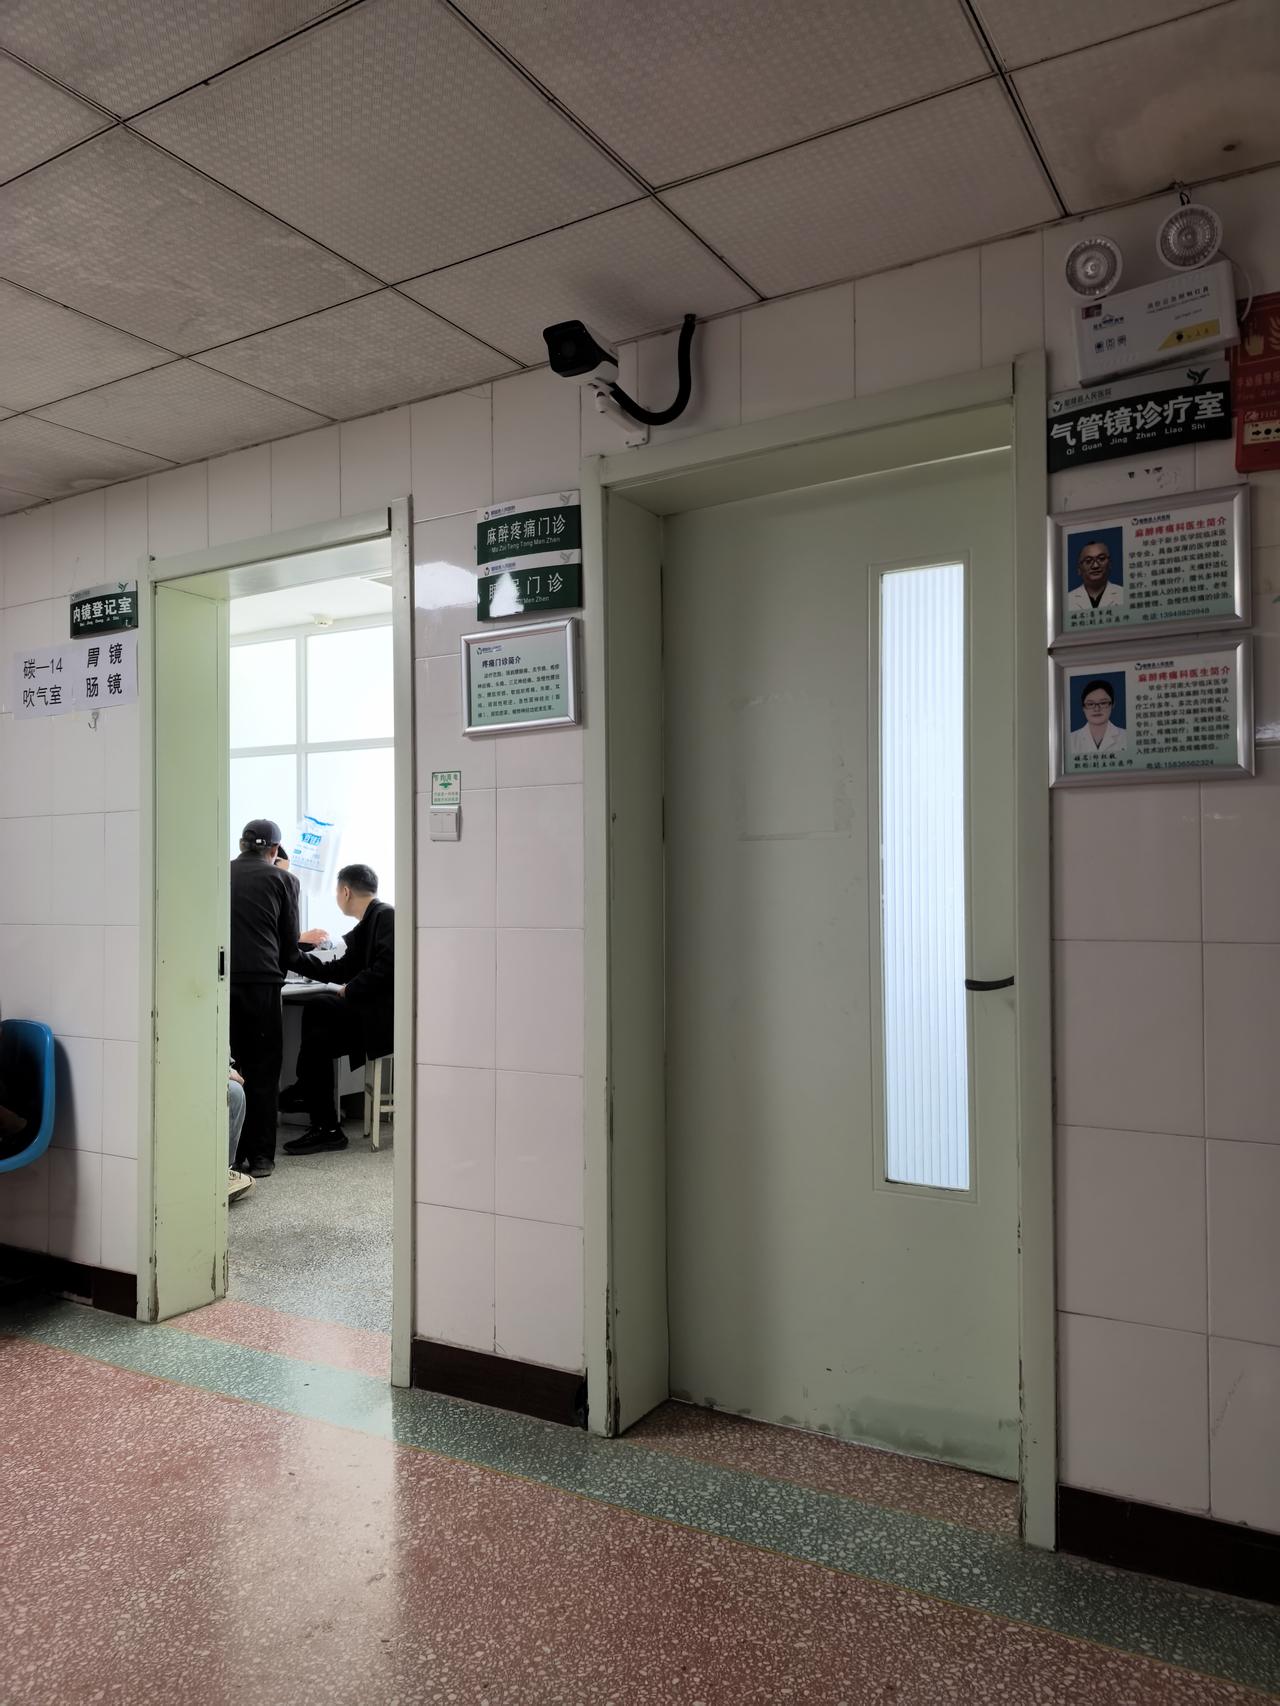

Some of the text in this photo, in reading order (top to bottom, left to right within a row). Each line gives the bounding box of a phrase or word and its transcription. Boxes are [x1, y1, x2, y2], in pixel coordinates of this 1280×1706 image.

[1050, 391, 1225, 447] 气管镜诊疗室
[487, 514, 566, 546] 麻醉疼痛门诊
[1135, 515, 1227, 538] 麻醉疼痛科医生简介
[73, 597, 133, 623] 内镜登记室
[1138, 666, 1231, 683] 麻醉疼痛科医生简介
[23, 684, 62, 708] 吹气室
